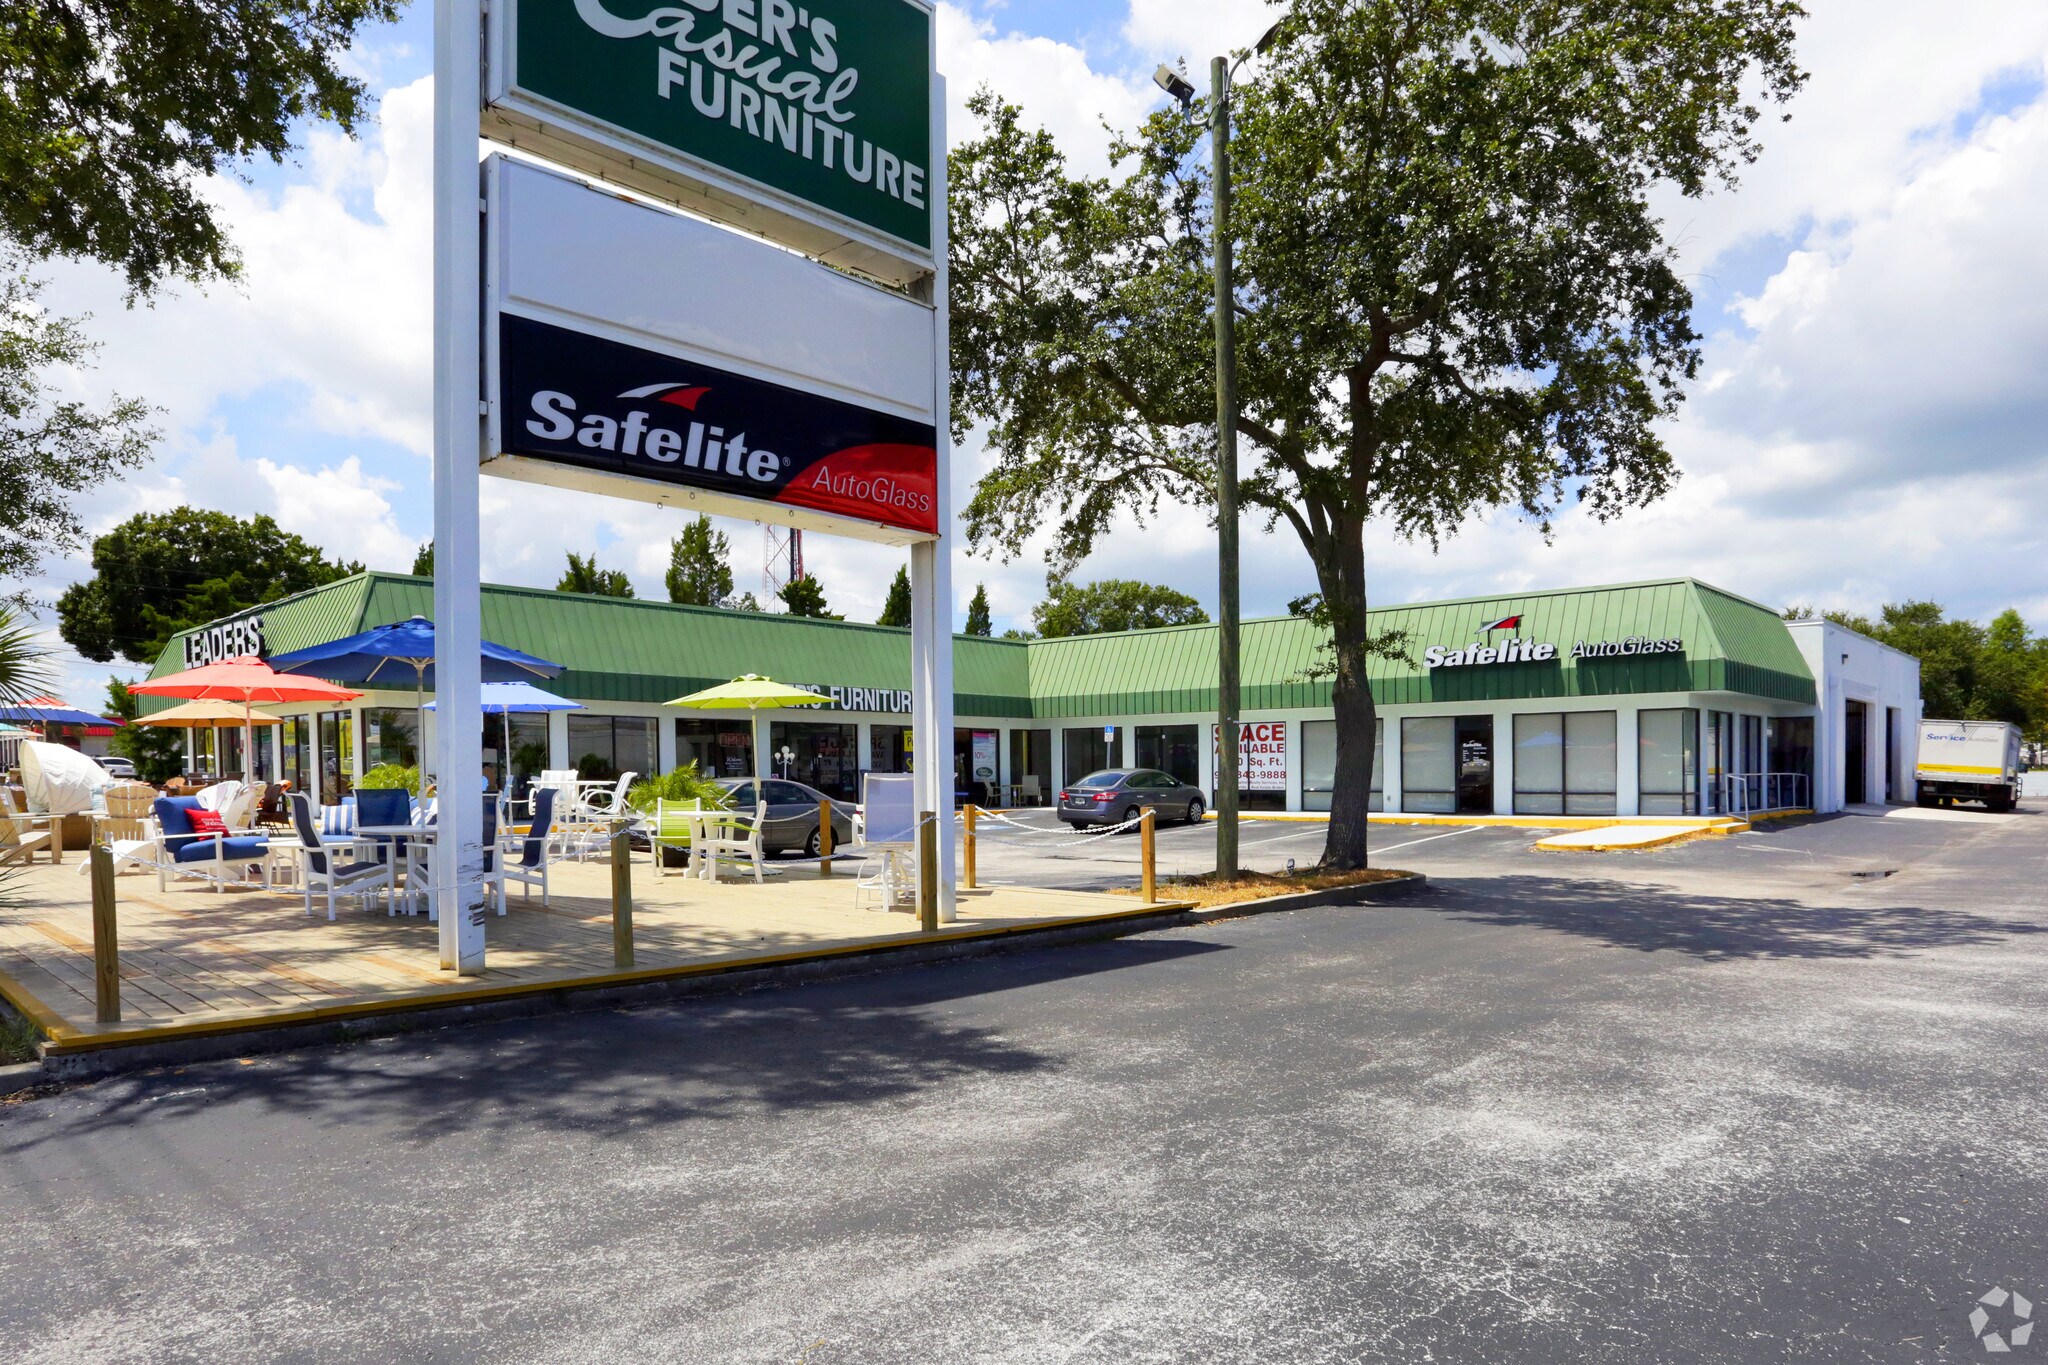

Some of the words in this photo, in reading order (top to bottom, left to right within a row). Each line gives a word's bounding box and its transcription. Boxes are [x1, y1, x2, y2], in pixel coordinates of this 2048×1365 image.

[657, 46, 926, 210] FURNITURE
[812, 465, 930, 512] AutoGlass
[184, 615, 261, 669] LEADER'S
[1423, 636, 1556, 668] Safelite
[1569, 636, 1682, 658] AutoGlass
[830, 686, 912, 713] FURNITUR
[1926, 733, 1966, 741] Service
[1250, 757, 1265, 768] Sq.
[1269, 757, 1282, 766] Ft.
